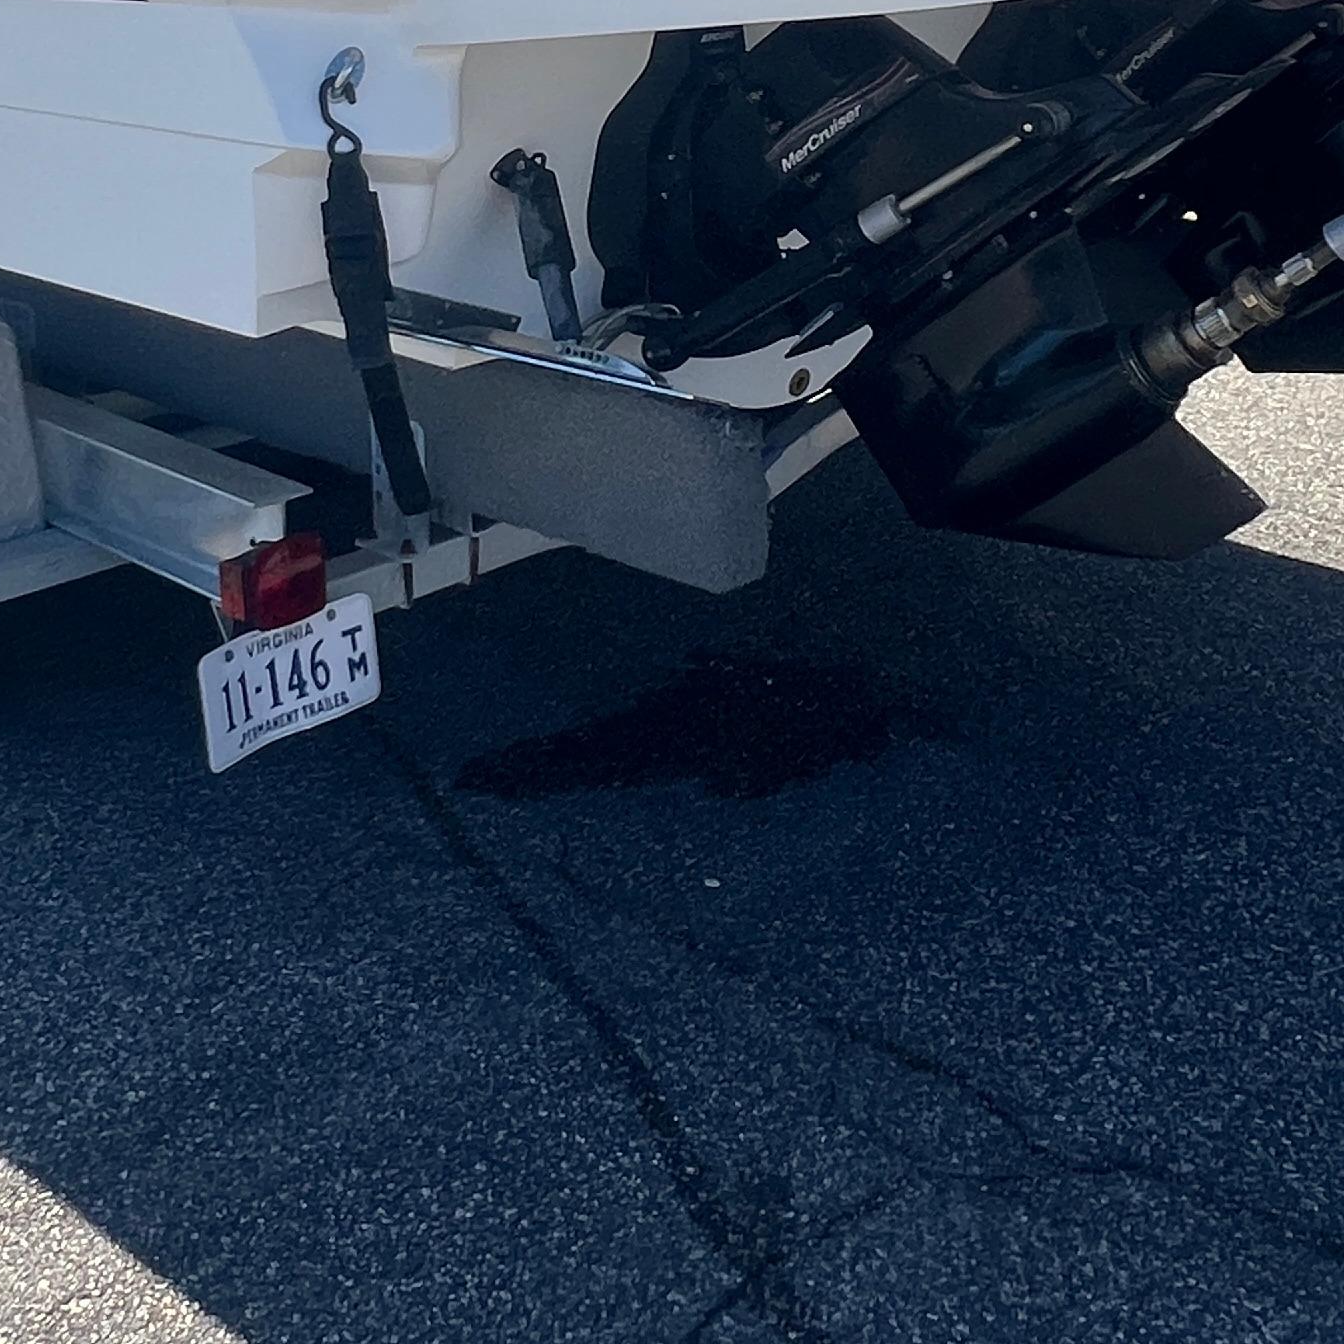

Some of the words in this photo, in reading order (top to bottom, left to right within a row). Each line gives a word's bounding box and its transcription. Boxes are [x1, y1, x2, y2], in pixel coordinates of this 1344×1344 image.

[780, 103, 862, 174] MerCruiser
[245, 622, 315, 658] VIRGINIA
[222, 638, 331, 734] 11-146
[239, 708, 300, 750] PERMANENT
[301, 690, 351, 720] TRAILER
